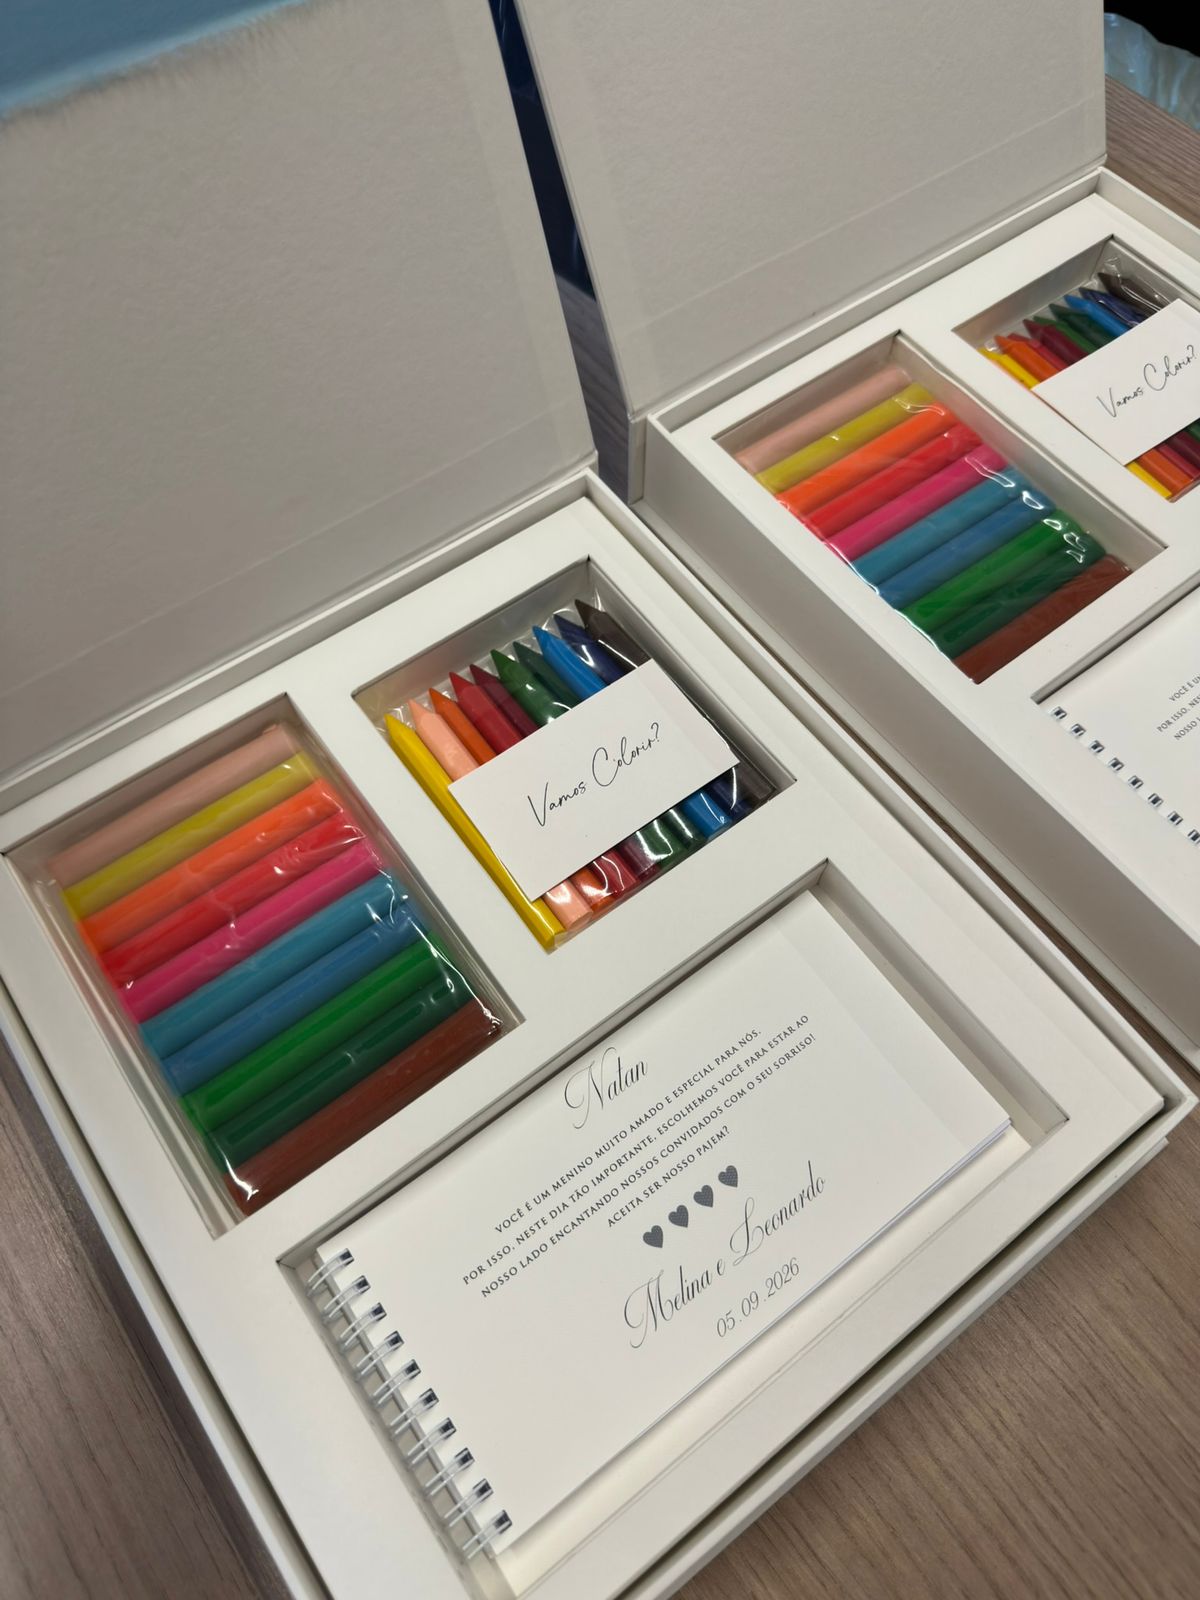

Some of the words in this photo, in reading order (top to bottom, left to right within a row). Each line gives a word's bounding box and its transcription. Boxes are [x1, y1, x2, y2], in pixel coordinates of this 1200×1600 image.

[1096, 387, 1144, 418] Vamos
[1143, 344, 1197, 392] Colorir?
[527, 781, 588, 827] Vamos
[591, 721, 660, 787] Colorir?
[1156, 719, 1173, 733] POR
[1173, 719, 1198, 741] NOSSO
[494, 1207, 525, 1234] VOCÊ
[524, 1201, 533, 1212] É
[532, 1189, 552, 1206] UM
[551, 1156, 594, 1193] MENINO
[594, 1129, 628, 1160] MUITO
[629, 1101, 665, 1133] AMADO
[664, 1094, 673, 1104] E
[671, 1063, 716, 1099] ESPECIAL
[713, 1045, 740, 1066] PARA
[737, 1028, 762, 1048] NÓS.
[563, 1046, 649, 1130] Natan
[462, 1264, 487, 1286] POR
[515, 1216, 549, 1246] NESTE
[548, 1201, 570, 1220] DIA
[568, 1183, 590, 1204] TÃO
[656, 1084, 719, 1136] ESCOLHEMOS
[717, 1063, 745, 1088] VOCÊ
[743, 1046, 769, 1068] PARA
[767, 1025, 797, 1050] ESTAR
[795, 1014, 809, 1029] AO
[480, 1266, 518, 1298] NOSSO
[518, 1242, 549, 1269] LADO
[549, 1187, 620, 1246] ENCANTANDO
[619, 1155, 660, 1191] NOSSOS
[659, 1105, 724, 1159] CONVIDADOS
[723, 1088, 747, 1109] COM
[745, 1081, 756, 1091] O
[754, 1065, 774, 1084] SEU
[772, 1032, 817, 1071] SORRISO!
[606, 1196, 644, 1228] ACEITA
[642, 1180, 664, 1199] SER
[661, 1153, 697, 1184] NOSSO
[695, 1124, 731, 1157] PAJEM?
[623, 1265, 713, 1349] Melina
[715, 1258, 726, 1277] e
[728, 1159, 826, 1266] Leonardo
